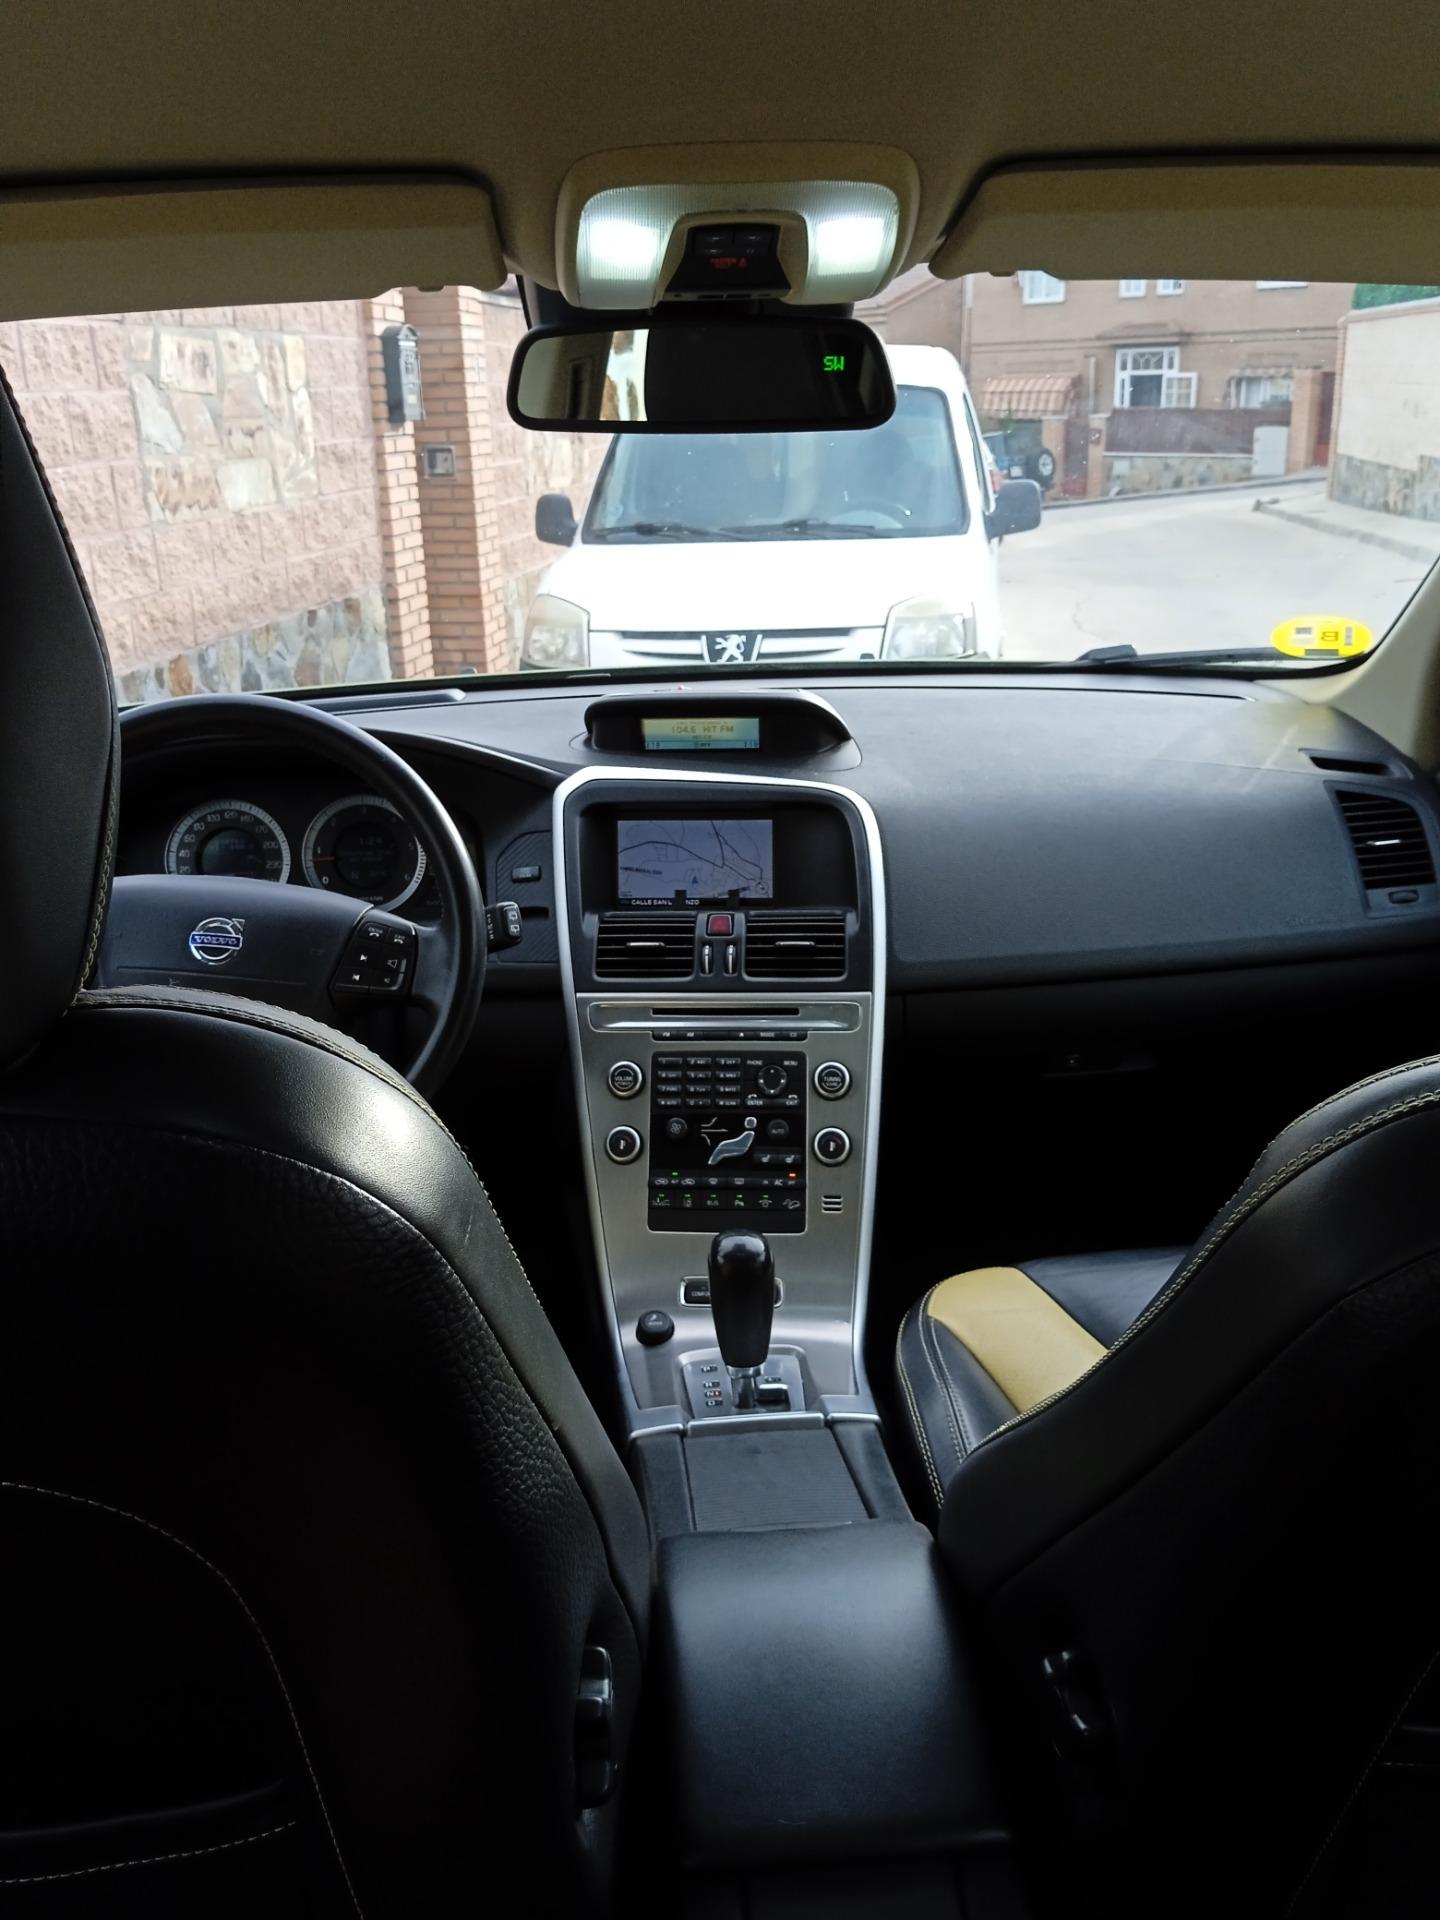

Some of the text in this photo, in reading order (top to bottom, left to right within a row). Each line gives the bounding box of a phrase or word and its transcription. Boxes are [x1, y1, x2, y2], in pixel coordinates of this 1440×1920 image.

[823, 355, 845, 371] SW
[193, 935, 238, 946] VOLVO
[774, 1178, 784, 1186] AC
